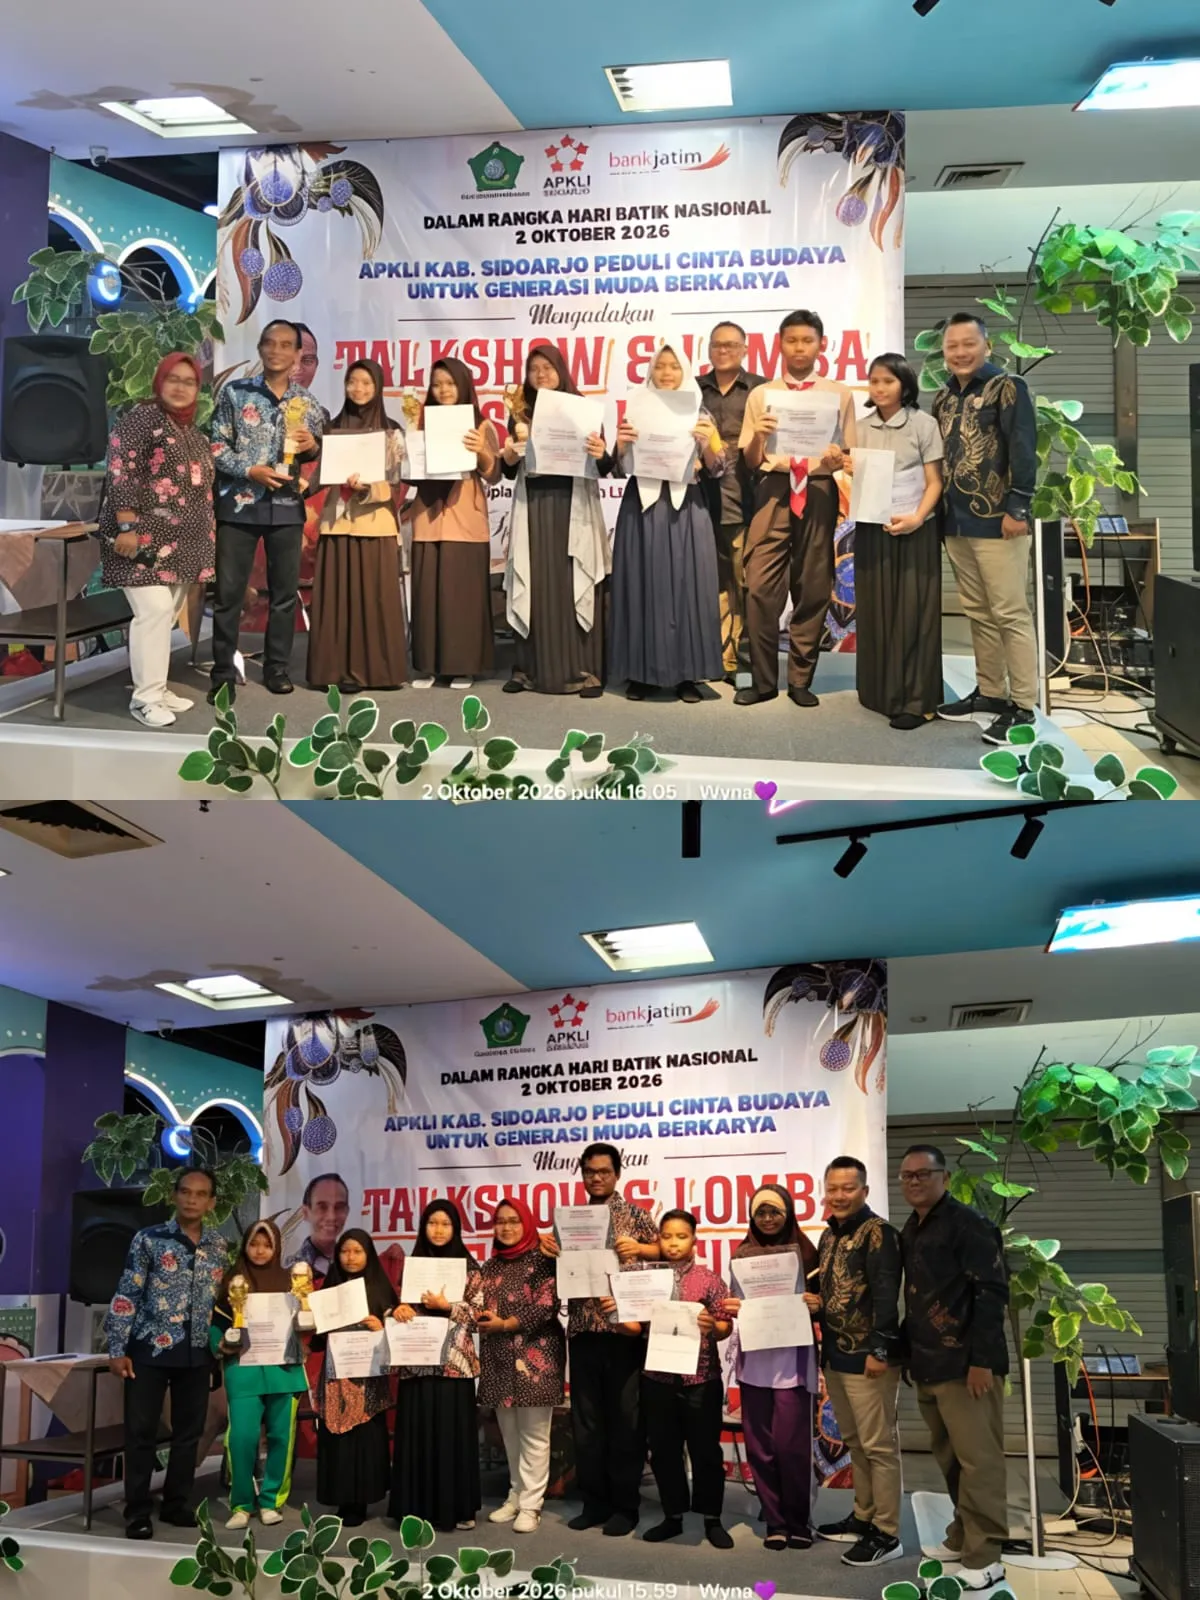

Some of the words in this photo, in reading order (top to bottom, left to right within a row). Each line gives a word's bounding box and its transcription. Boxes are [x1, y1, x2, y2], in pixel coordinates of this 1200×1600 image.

[609, 149, 702, 170] bankjatim
[543, 174, 591, 189] APKLI
[423, 212, 485, 231] DALAM
[488, 208, 562, 227] RANGKA
[568, 207, 611, 224] HARI
[616, 204, 669, 222] BATIK
[674, 199, 771, 218] NASIONAL
[515, 230, 527, 245] 2
[531, 226, 615, 244] OKTOBER
[621, 224, 670, 240] 2026
[358, 261, 420, 280] APKLI
[425, 260, 476, 278] KAB.
[481, 256, 589, 277] SIDOARJO
[594, 252, 671, 273] PEDULI
[676, 250, 744, 270] CINTA
[750, 245, 846, 267] BUDAYA
[407, 282, 479, 300] UNTUK
[485, 278, 589, 298] GENERASI
[595, 276, 659, 294] MUDA
[665, 270, 790, 292] BERKARYA
[529, 301, 655, 331] Mengadakan
[335, 334, 605, 388] TALSHW
[606, 1003, 692, 1023] bankjatim
[547, 1030, 589, 1044] APKLI
[440, 1066, 494, 1085] DALAM
[498, 1062, 564, 1081] RANGKA
[568, 1059, 608, 1077] HARI
[613, 1055, 661, 1072] BATIK
[666, 1048, 758, 1068] NASIONAL
[521, 1083, 532, 1096] 2
[536, 1077, 612, 1095] OKTOBER
[618, 1073, 663, 1090] 2026
[384, 1115, 437, 1132] APKLI
[441, 1112, 486, 1129] KAB.
[491, 1106, 587, 1127] SIDOARJO
[592, 1101, 664, 1120] PEDULI
[668, 1096, 733, 1116] CINTA
[738, 1090, 830, 1112] BUDAYA
[426, 1132, 489, 1150] UNTUK
[494, 1127, 587, 1147] GENERASI
[592, 1122, 653, 1141] MUDA
[658, 1115, 777, 1138] BERKARYA
[533, 1148, 649, 1176] Mengkan
[674, 1172, 833, 1225] LOMB
